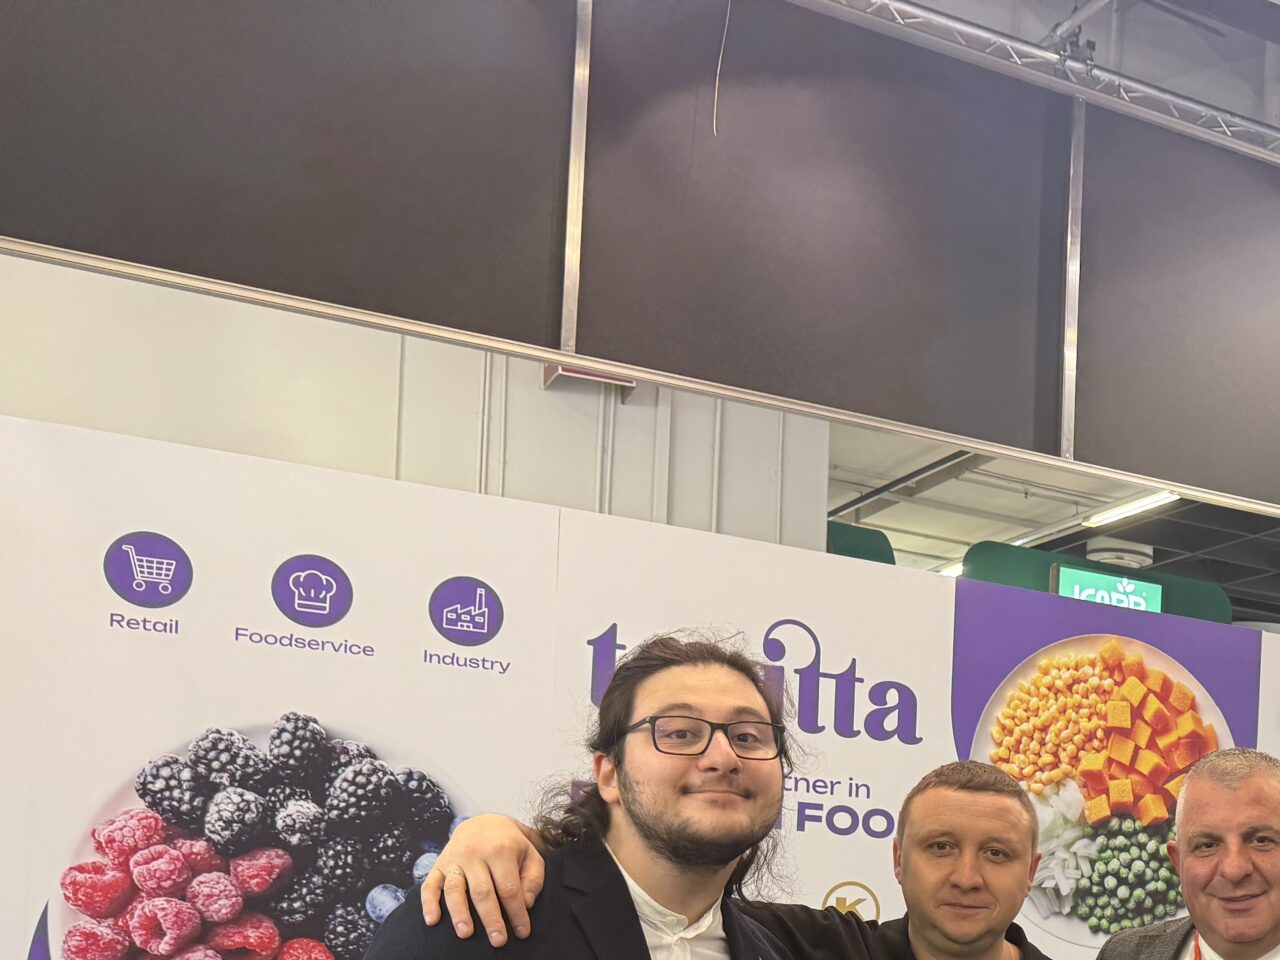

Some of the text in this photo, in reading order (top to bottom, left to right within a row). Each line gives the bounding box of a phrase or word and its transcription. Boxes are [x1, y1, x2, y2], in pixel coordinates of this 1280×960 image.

[109, 612, 179, 634] Retail
[234, 627, 375, 657] Foodservice
[423, 649, 511, 674] Industry
[587, 619, 923, 745] titta
[783, 774, 871, 799] tner in
[796, 801, 896, 839] FOO
